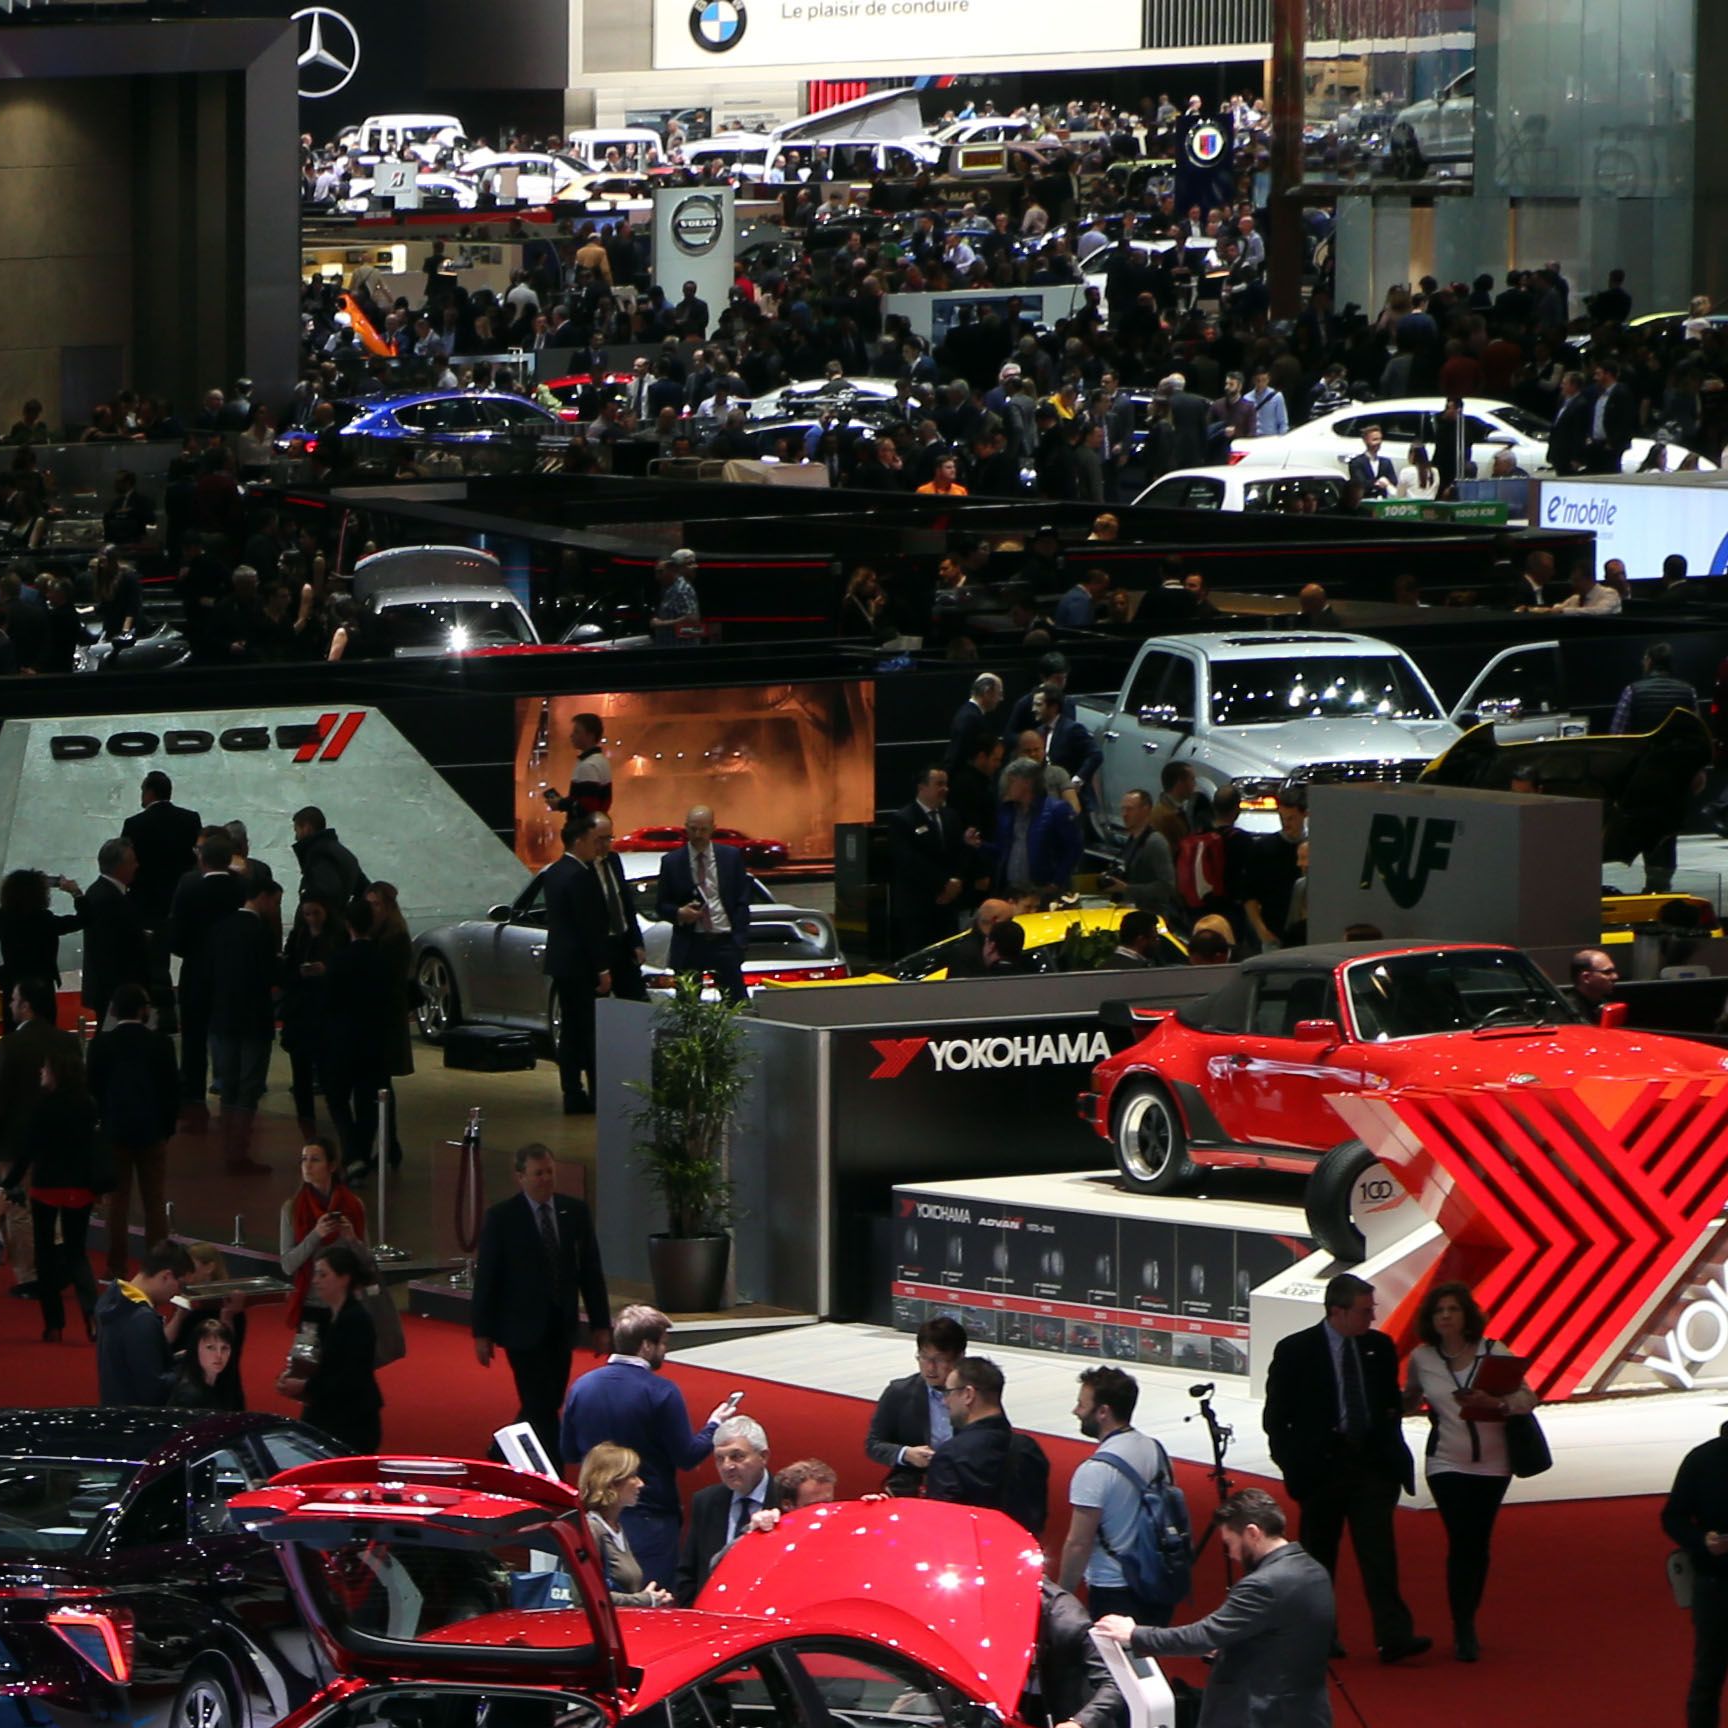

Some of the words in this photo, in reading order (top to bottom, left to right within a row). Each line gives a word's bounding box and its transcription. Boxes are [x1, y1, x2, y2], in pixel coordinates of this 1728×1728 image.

[781, 5, 802, 19] Le
[808, 2, 860, 21] plaisir
[865, 1, 886, 15] de
[892, 0, 969, 14] conduire
[680, 219, 717, 228] VOLVO
[1384, 504, 1419, 517] 100%
[1548, 495, 1617, 526] e'mobile
[50, 722, 321, 760] DODGE
[1360, 811, 1456, 909] RUF
[928, 1032, 1112, 1071] YOKOHAMA
[1359, 1180, 1393, 1199] 100
[916, 1203, 972, 1224] YOKOHAMA
[978, 1217, 1020, 1230] ADVAN
